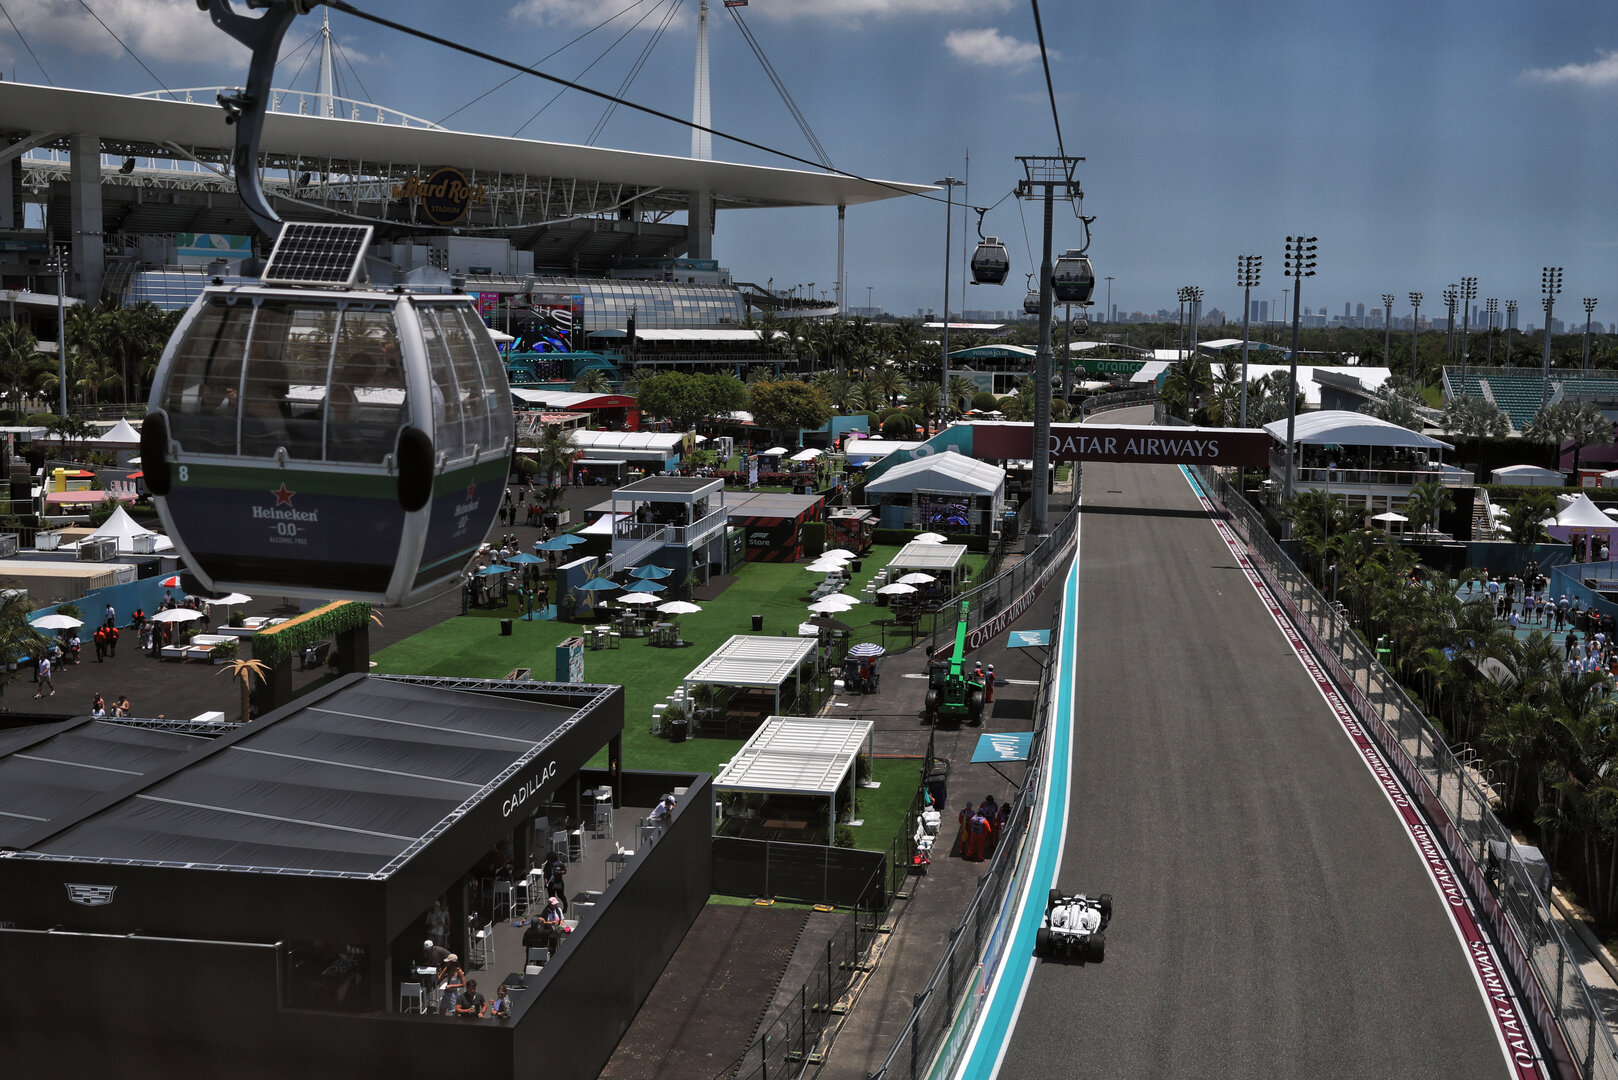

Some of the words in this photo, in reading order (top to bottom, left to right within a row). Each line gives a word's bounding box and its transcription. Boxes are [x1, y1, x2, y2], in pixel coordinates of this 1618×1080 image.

[402, 177, 449, 199] Hard
[448, 180, 485, 204] Rock
[1097, 361, 1142, 372] aramco
[1124, 438, 1218, 457] AIRWAYS
[178, 465, 189, 482] 8
[252, 506, 318, 522] Heineken
[748, 538, 770, 546] Store
[970, 615, 1006, 648] QATAR
[1007, 588, 1036, 622] AIRWAYS
[1351, 687, 1379, 741] QATAR
[1381, 728, 1426, 804] AIRWAYS
[502, 760, 556, 818] CADILLAC
[1410, 823, 1444, 866] AIRWAYS
[1435, 868, 1464, 906] QATAR
[1444, 822, 1488, 912] QATAR
[1489, 905, 1554, 1051] AIRWAYS
[1470, 940, 1509, 1004] AIRWAYS
[1498, 1007, 1534, 1068] QATAR
